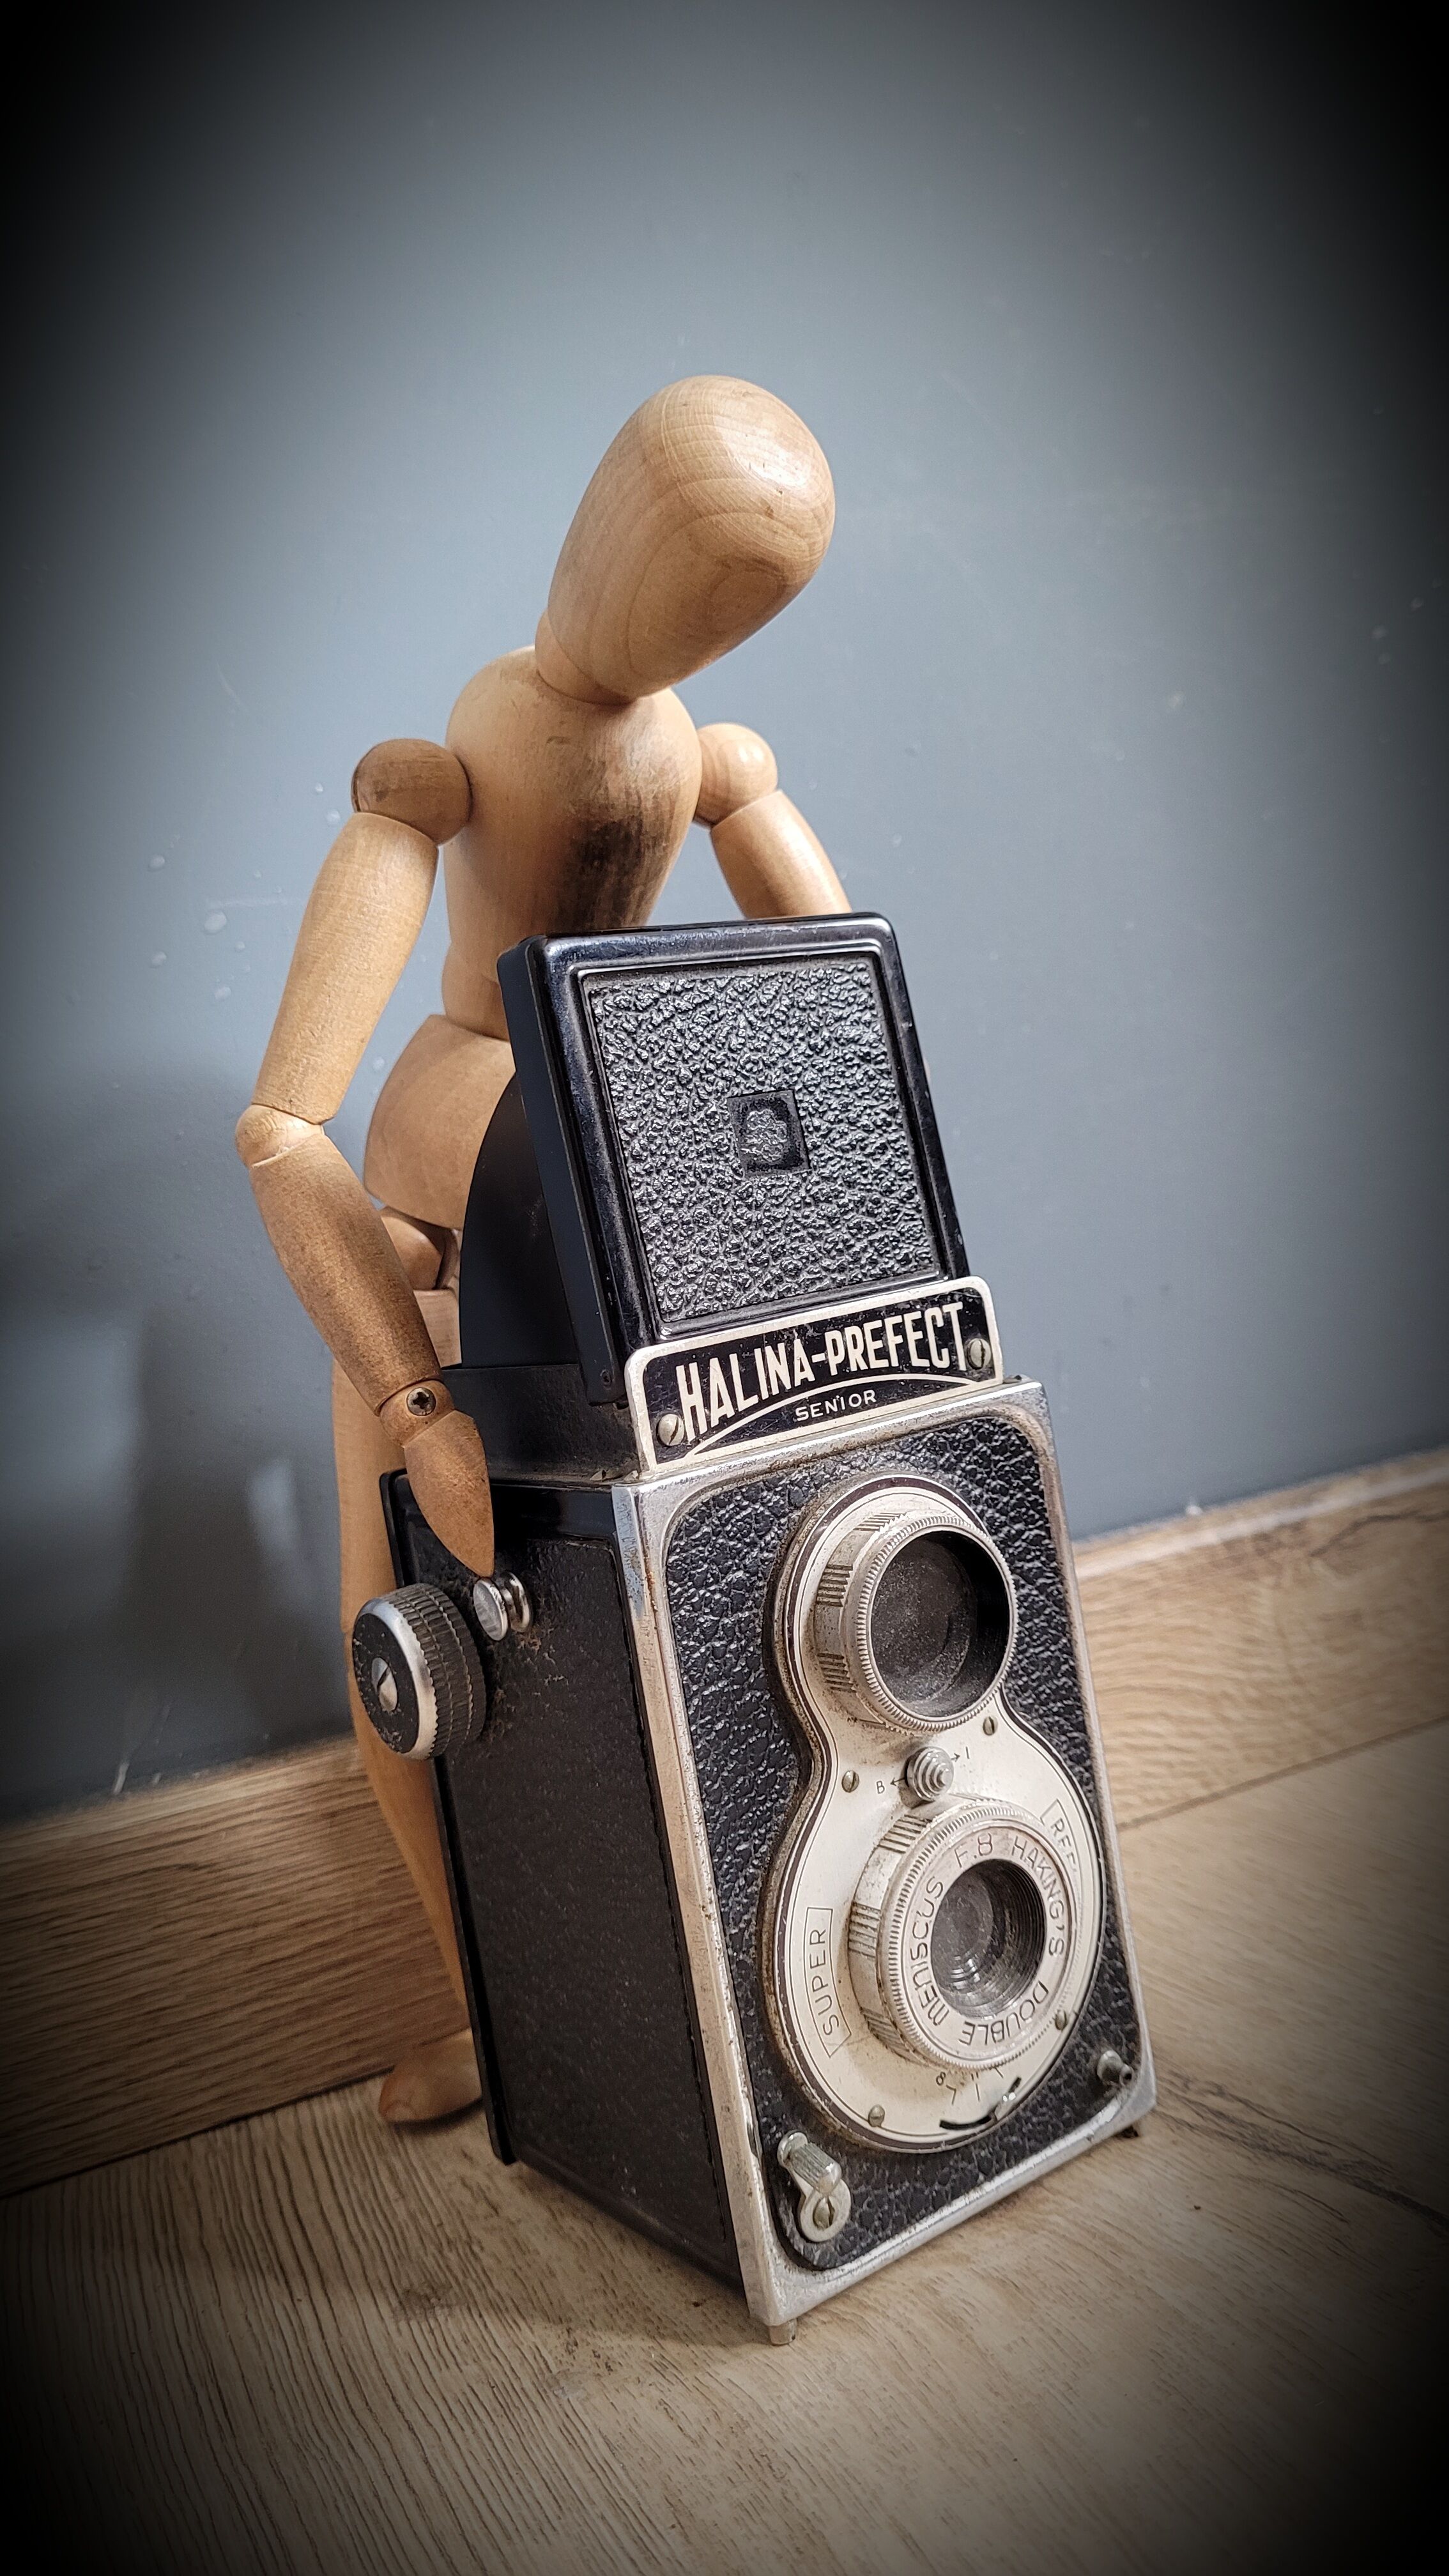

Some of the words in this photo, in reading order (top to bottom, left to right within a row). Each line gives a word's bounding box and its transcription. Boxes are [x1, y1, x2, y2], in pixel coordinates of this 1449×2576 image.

[676, 1301, 967, 1442] HALINA-PREFECT
[795, 1390, 877, 1422] SENIOR
[876, 1780, 885, 1795] B
[954, 1832, 993, 1868] F.8
[1011, 1835, 1066, 1957] HAKING'S
[809, 1929, 839, 2036] SUPER
[910, 1876, 950, 2026] MENISCUS
[958, 1981, 1049, 2046] DOUBLE
